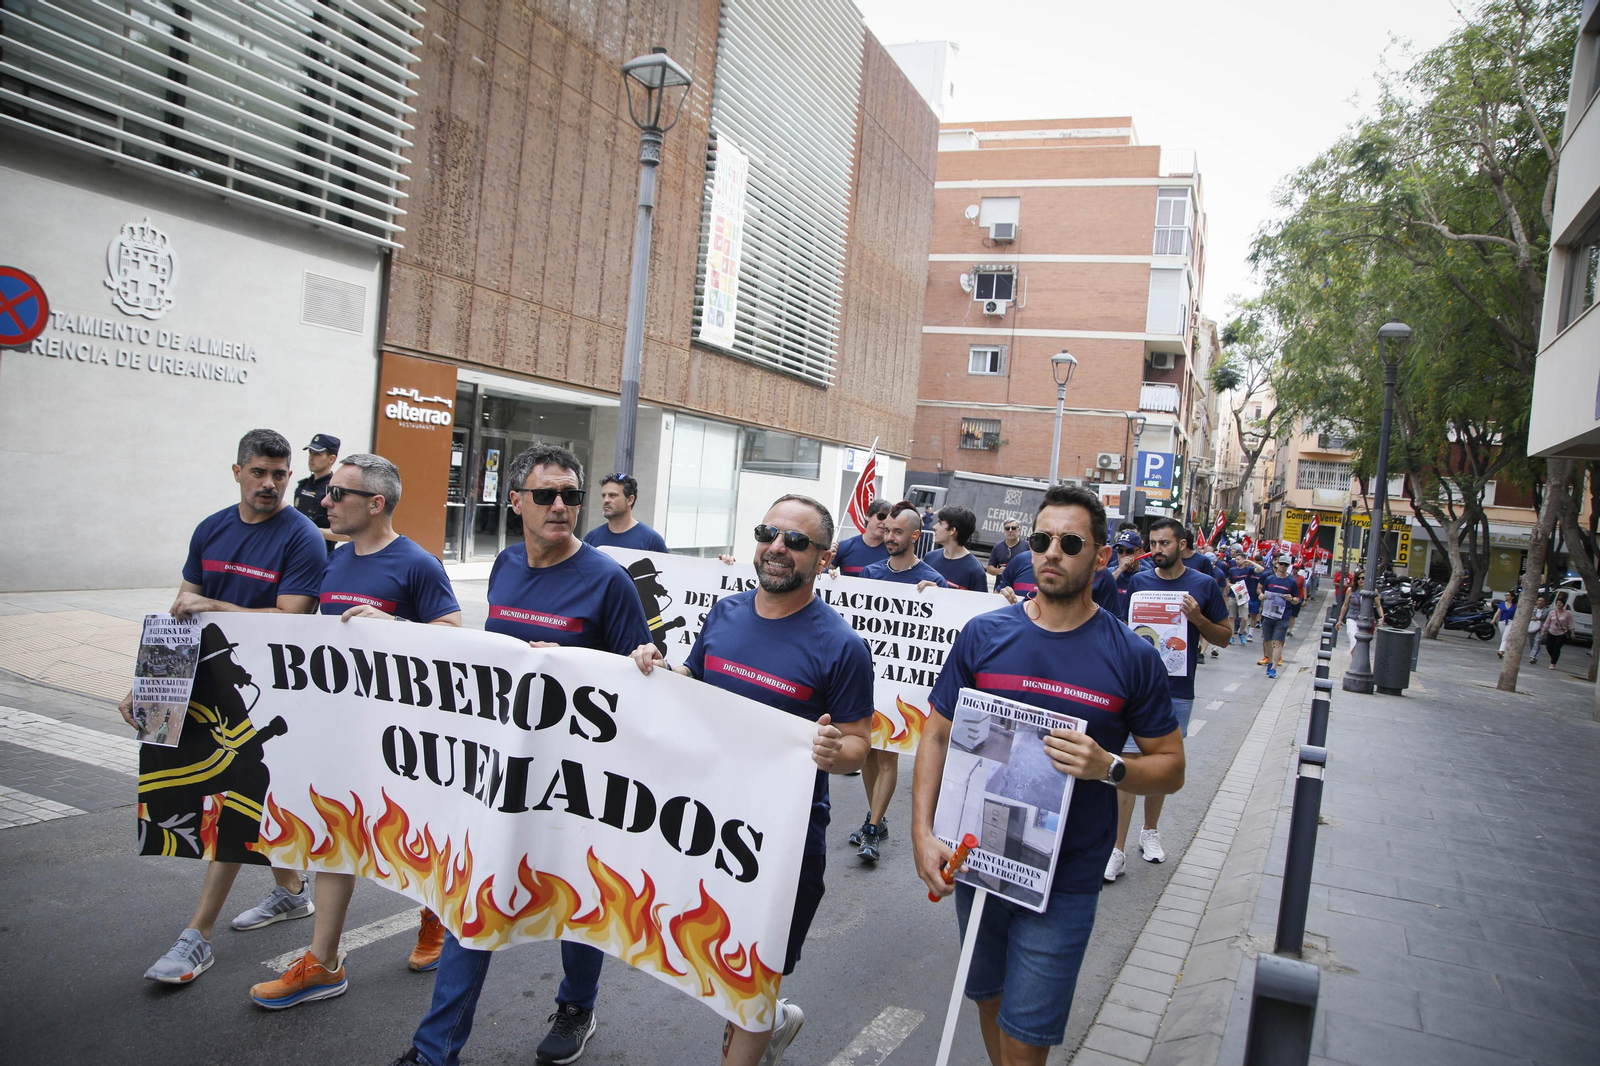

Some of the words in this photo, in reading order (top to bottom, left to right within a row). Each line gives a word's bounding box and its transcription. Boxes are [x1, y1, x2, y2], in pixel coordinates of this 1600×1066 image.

[157, 329, 182, 350] DE
[116, 348, 142, 369] DE
[147, 353, 249, 384] URBANISMO
[385, 400, 452, 426] elterrao
[1144, 453, 1165, 479] P
[988, 507, 1033, 525] CERVEZAS
[1286, 510, 1314, 522] Compr
[981, 519, 1034, 538] ALHARA
[720, 575, 757, 592] LAS
[352, 595, 383, 608] BOMBEROS
[500, 609, 530, 620] DIGNIDAD
[530, 614, 568, 627] BOMBEROS
[166, 636, 193, 644] UNESPA
[178, 627, 191, 635] LOS
[723, 663, 756, 679] DIGNIDAD
[756, 673, 797, 694] BOMBEROS
[135, 694, 160, 702] PARQUE
[160, 694, 168, 702] DE
[139, 686, 147, 694] EL
[147, 686, 170, 694] DINERO
[267, 643, 619, 743] BOMBEROS
[1022, 679, 1062, 693] DIGNIDAD
[1063, 688, 1110, 706] BOMBEROS
[962, 697, 1011, 718] DIGNIDAD
[381, 725, 764, 883] QUEMADOS
[972, 858, 989, 873] DEN
[991, 865, 1035, 889] VERGÜEZA
[977, 849, 1042, 880] INSTALACIONES
